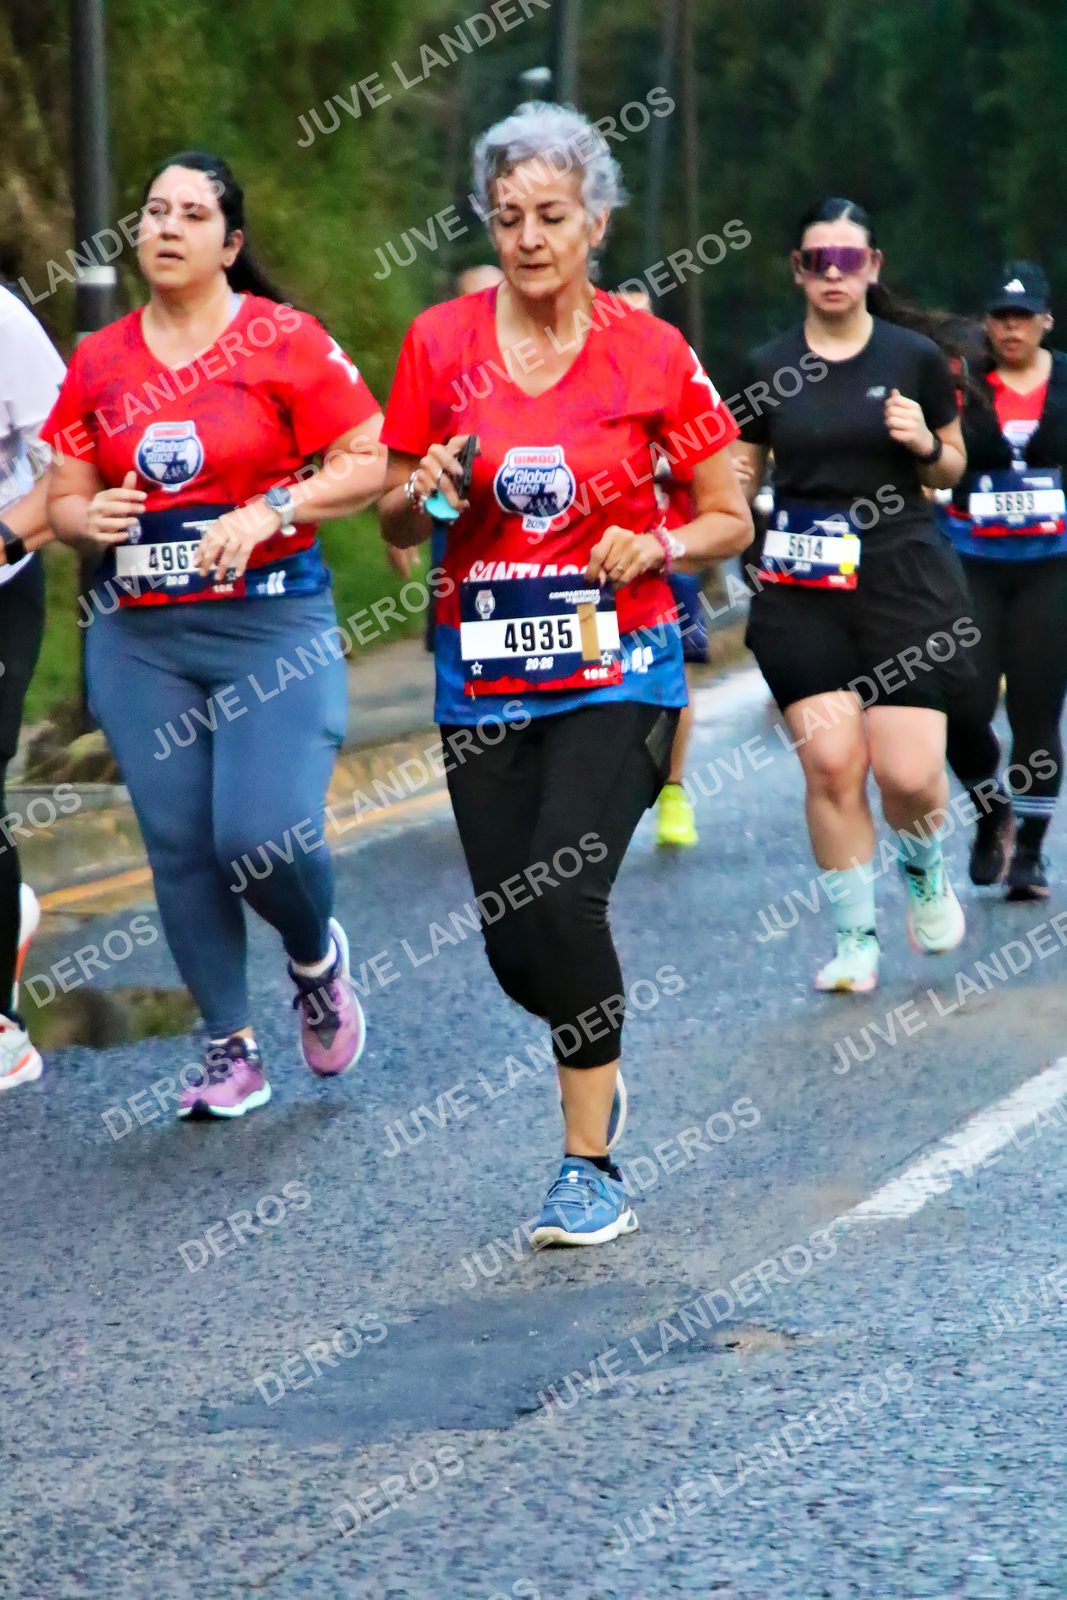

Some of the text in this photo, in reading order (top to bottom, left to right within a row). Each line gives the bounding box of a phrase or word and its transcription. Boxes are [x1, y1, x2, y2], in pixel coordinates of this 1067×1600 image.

[513, 455, 556, 465] BIMBO
[513, 468, 556, 484] Global
[507, 482, 541, 496] Race
[994, 492, 1035, 512] 5693
[788, 535, 823, 560] 5614
[462, 560, 588, 582] SANTIA
[504, 618, 573, 653] 4935
[583, 667, 609, 680] 10K
